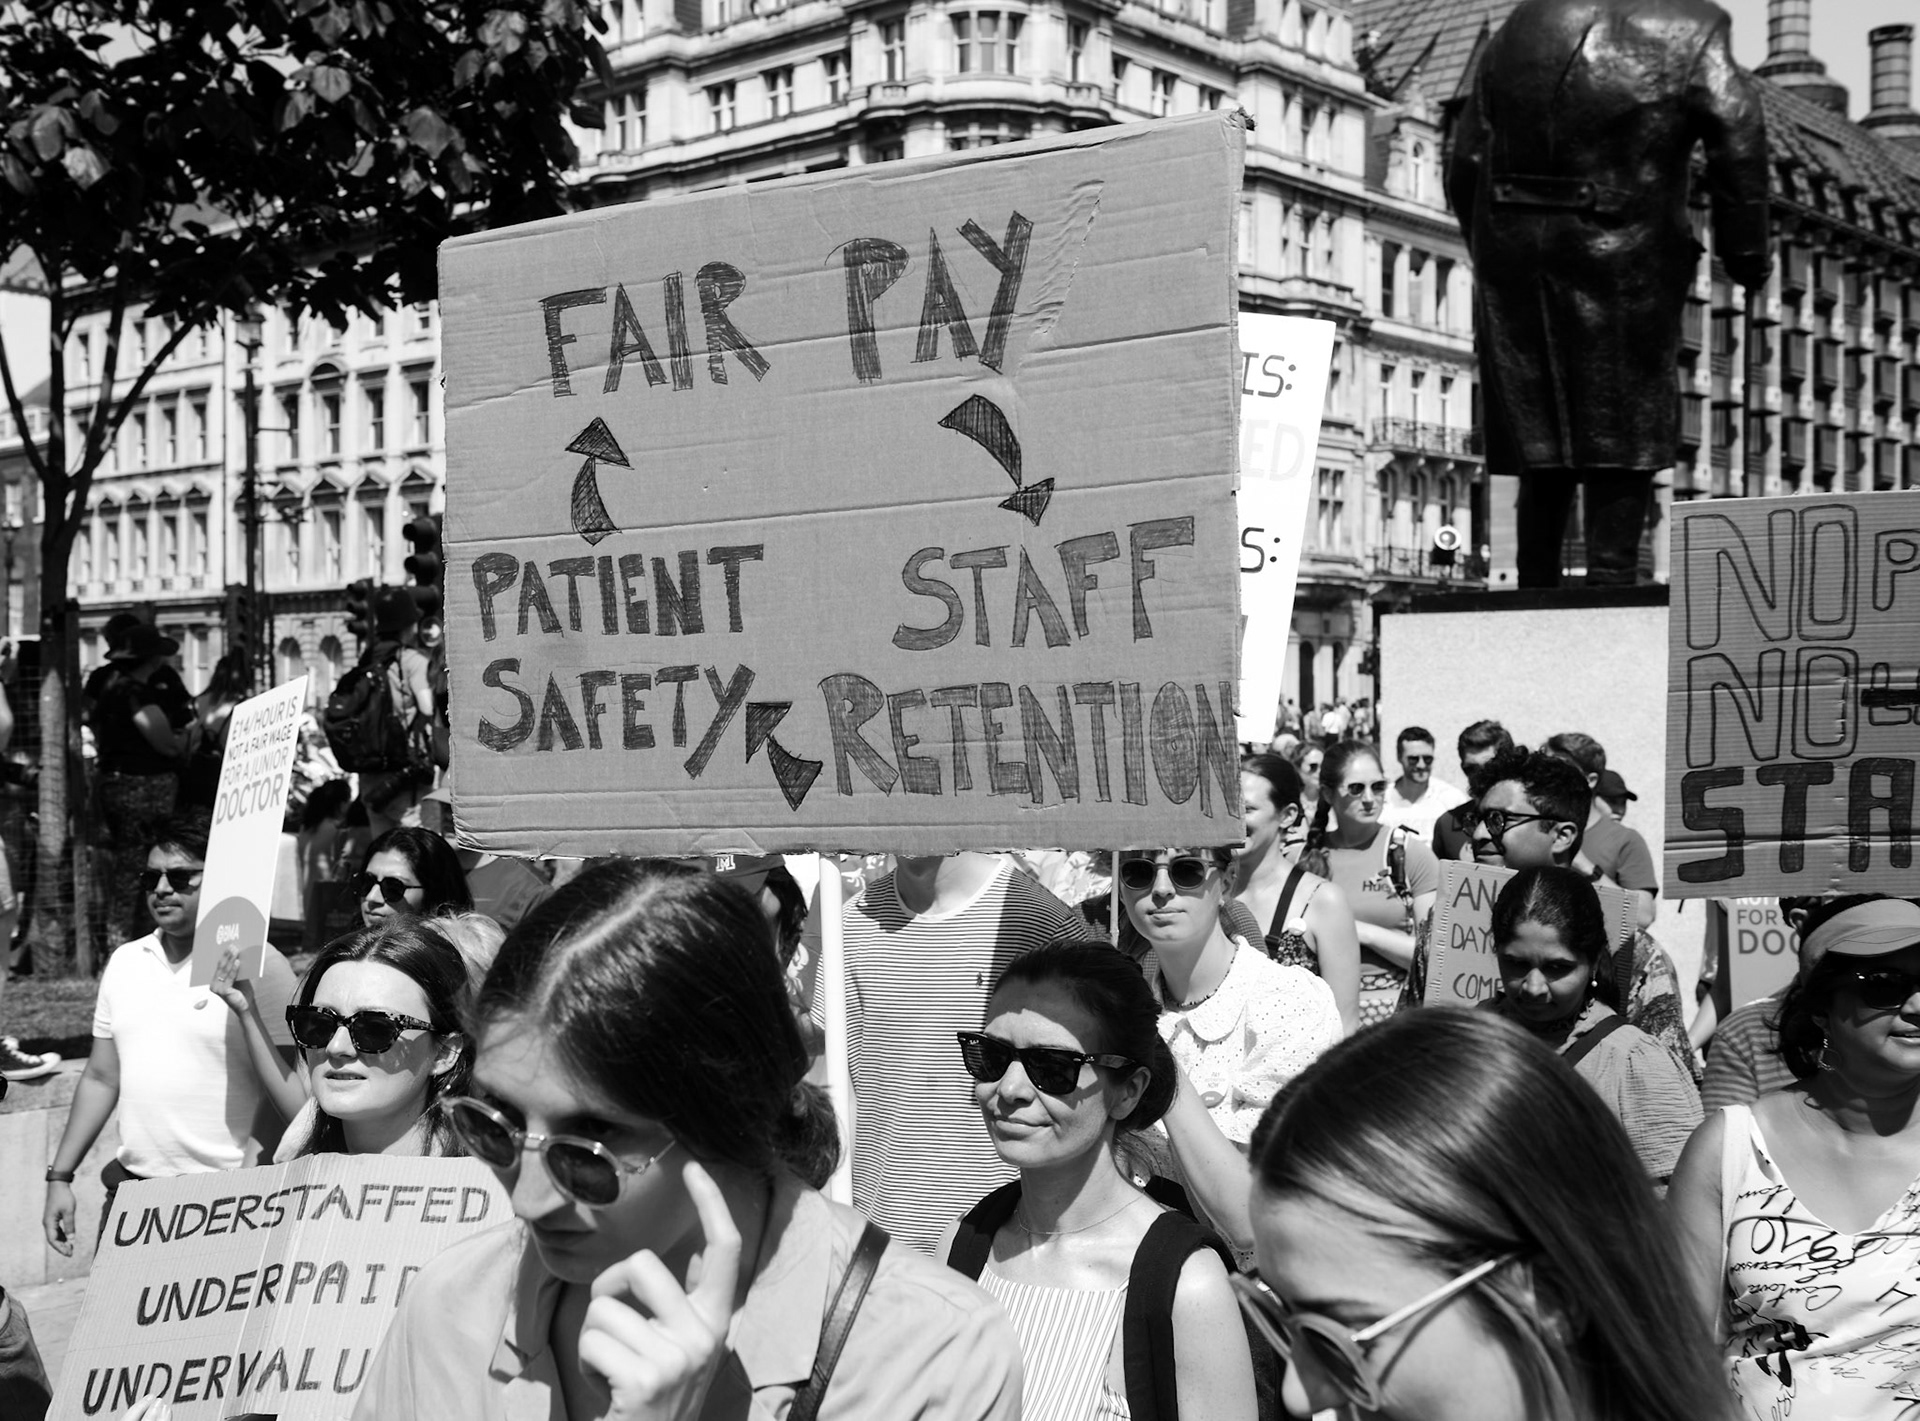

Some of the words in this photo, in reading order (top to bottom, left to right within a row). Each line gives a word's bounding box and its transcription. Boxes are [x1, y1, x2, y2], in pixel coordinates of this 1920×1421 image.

[538, 261, 771, 398] FAIR
[826, 210, 1034, 384] PAY
[472, 543, 764, 642] PATIENT
[891, 515, 1195, 651] STAFF
[1684, 503, 1859, 650] NO
[228, 742, 244, 762] NOT
[244, 741, 250, 756] A
[250, 732, 269, 754] FAIR
[269, 723, 294, 746] WAGE
[232, 701, 285, 742] £14/HOUR
[286, 695, 298, 719] IS
[477, 657, 756, 781] SAFETY
[817, 672, 1241, 819] RETENTION
[1685, 646, 1860, 768] NO
[216, 773, 284, 825] DOCTOR
[222, 763, 242, 788] FOR
[243, 765, 250, 780] A
[250, 746, 289, 782] JUNIOR
[1678, 757, 1915, 883] STA
[1452, 877, 1497, 911] AN
[1737, 909, 1777, 925] FOR
[114, 1184, 490, 1247] UNDERSTAFFED
[82, 1347, 372, 1417] UNDERVALU
